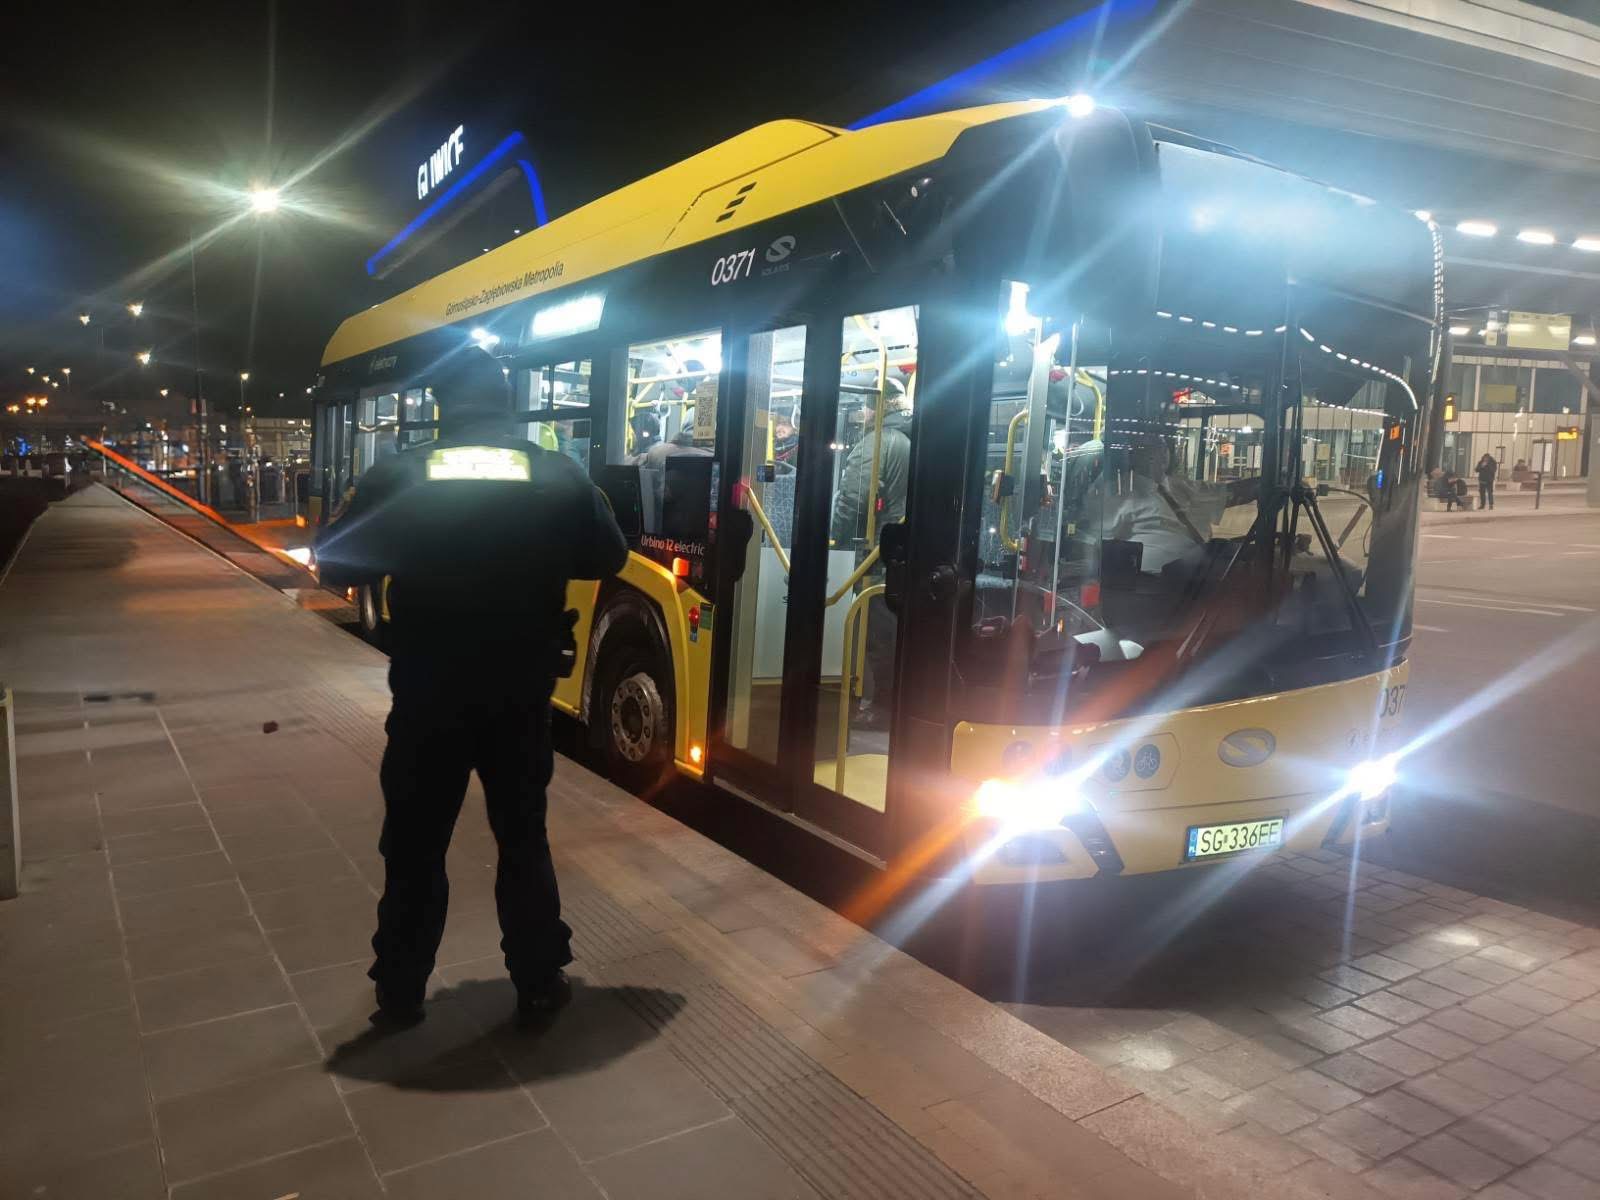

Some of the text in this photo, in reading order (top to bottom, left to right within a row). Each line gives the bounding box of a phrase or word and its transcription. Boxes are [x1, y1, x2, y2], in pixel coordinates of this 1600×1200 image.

[711, 248, 756, 286] 0371
[641, 535, 705, 556] Urbino 12 electric
